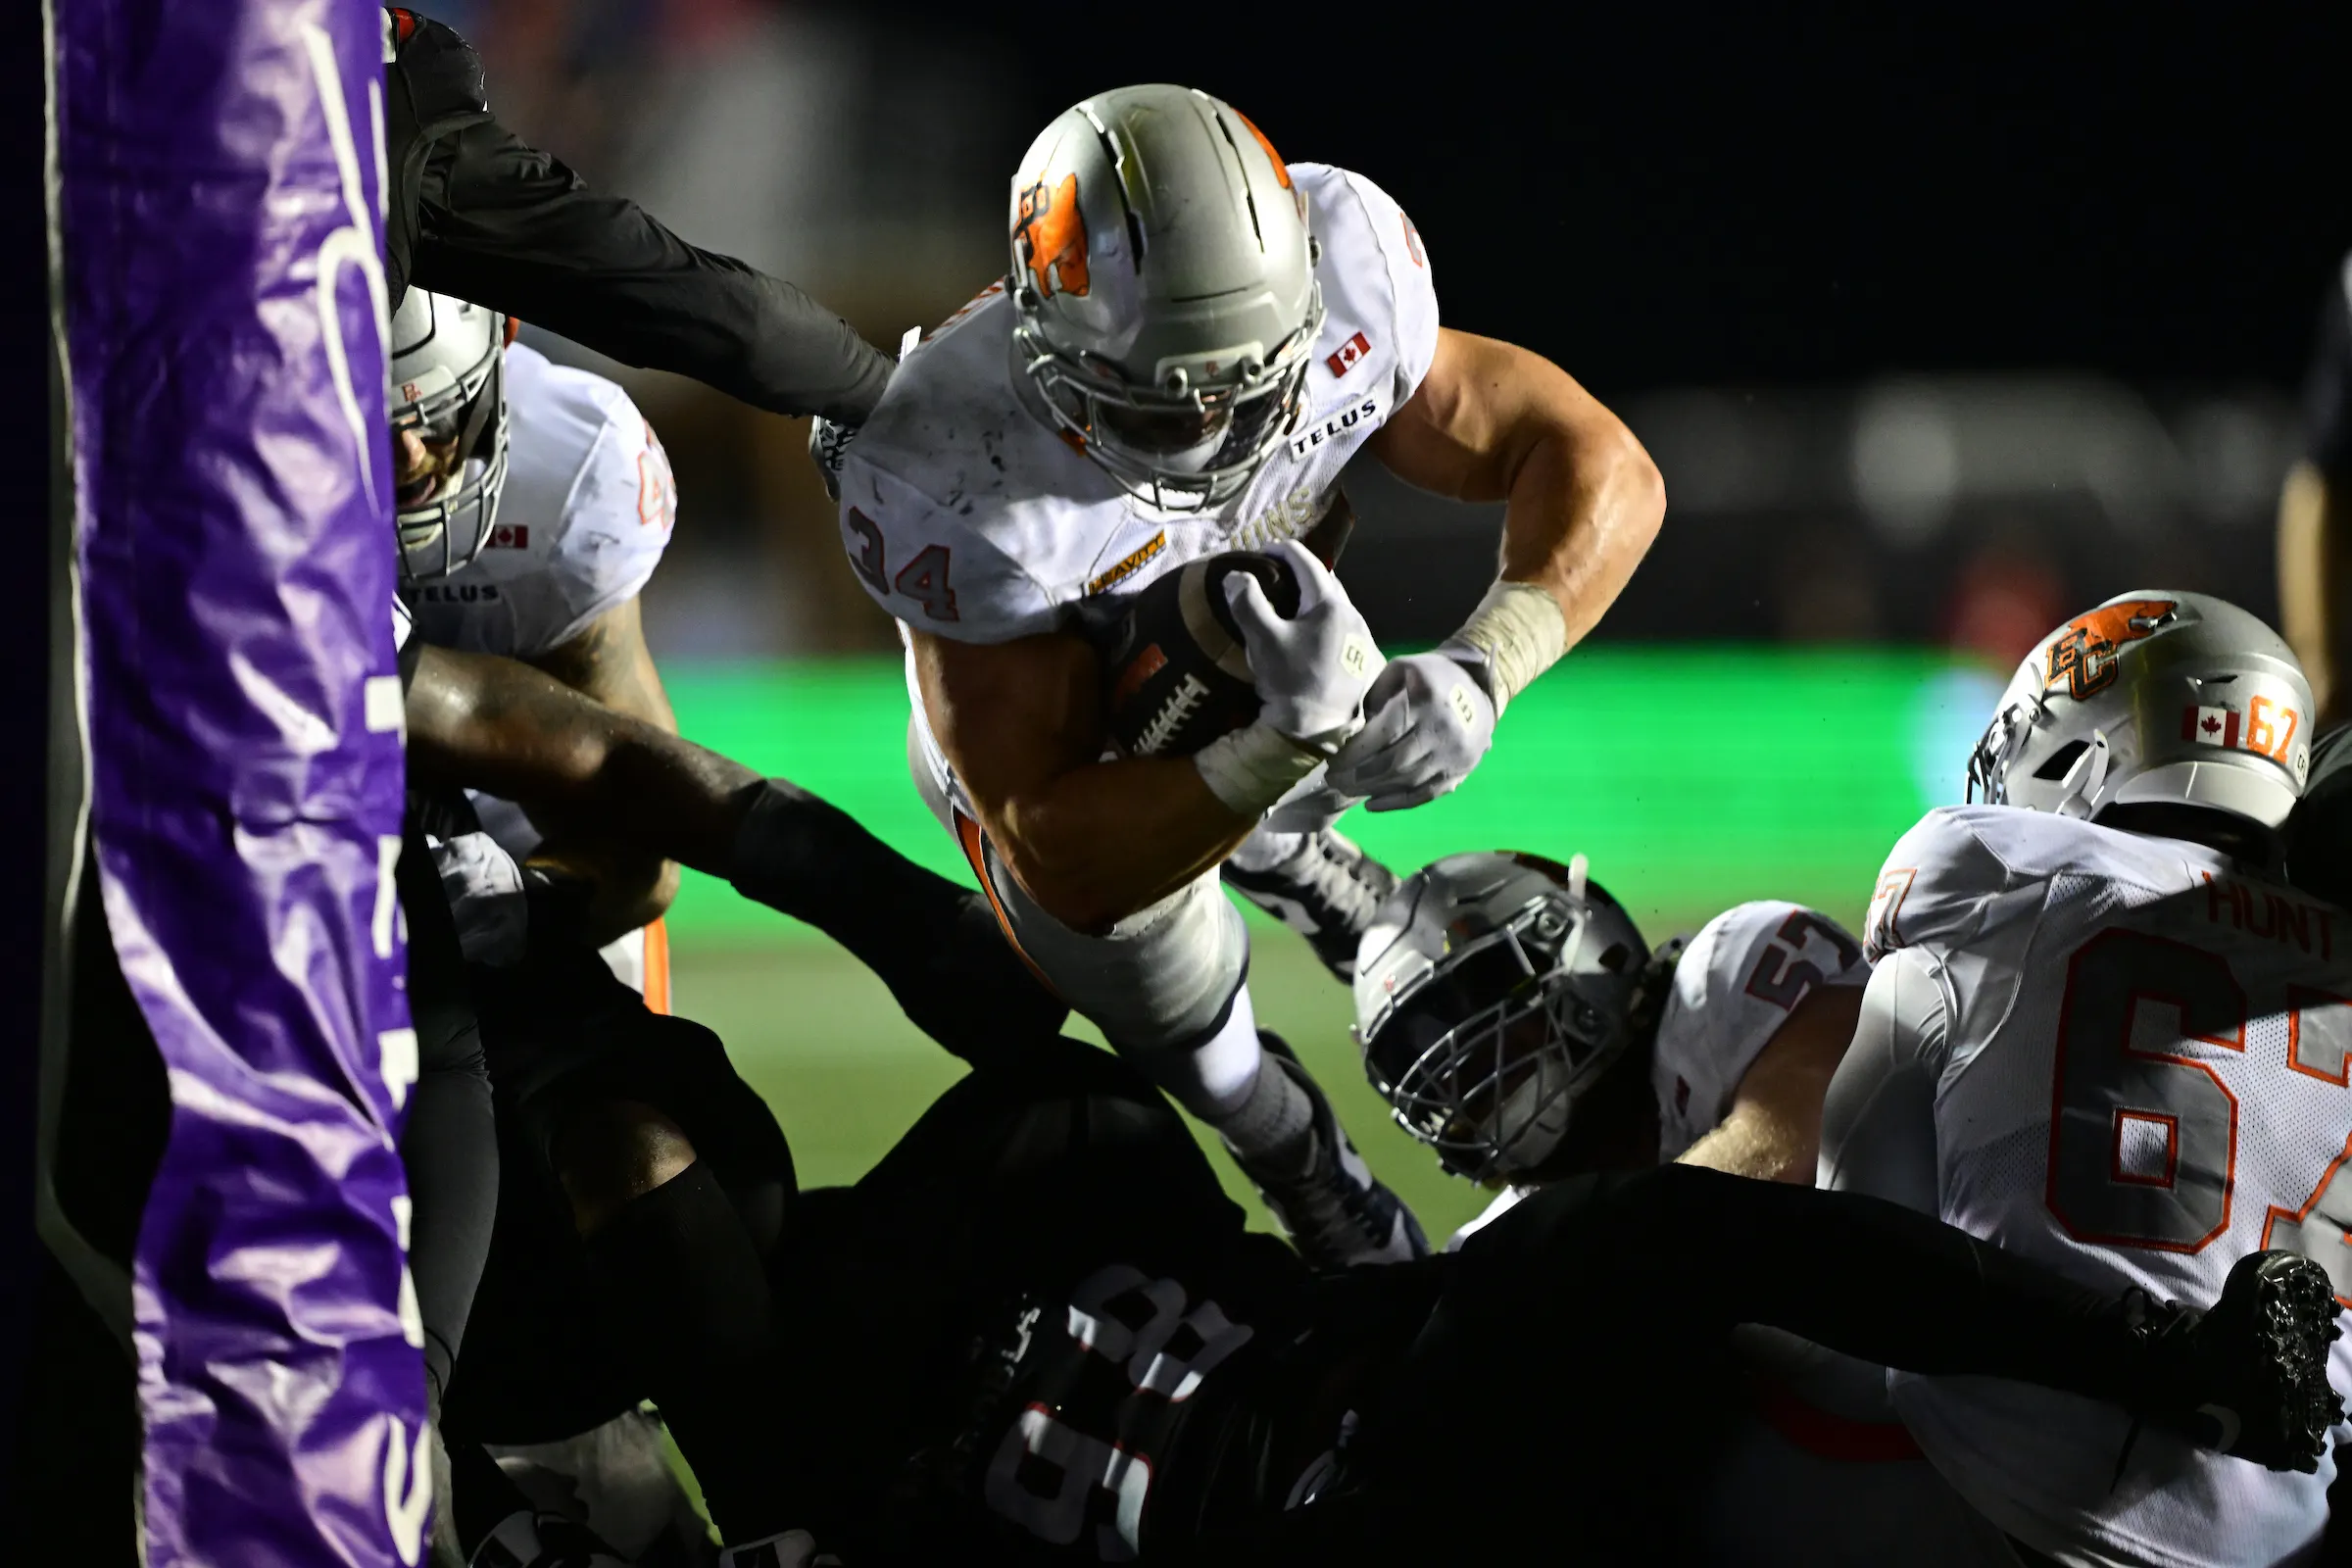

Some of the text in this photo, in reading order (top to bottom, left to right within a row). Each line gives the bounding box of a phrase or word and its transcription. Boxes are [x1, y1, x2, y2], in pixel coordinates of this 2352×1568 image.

[1294, 399, 1376, 454] TELUS
[848, 506, 960, 622] 34
[1345, 645, 1365, 672] CFL
[2246, 694, 2298, 764] 67
[2201, 870, 2334, 962] HUNT
